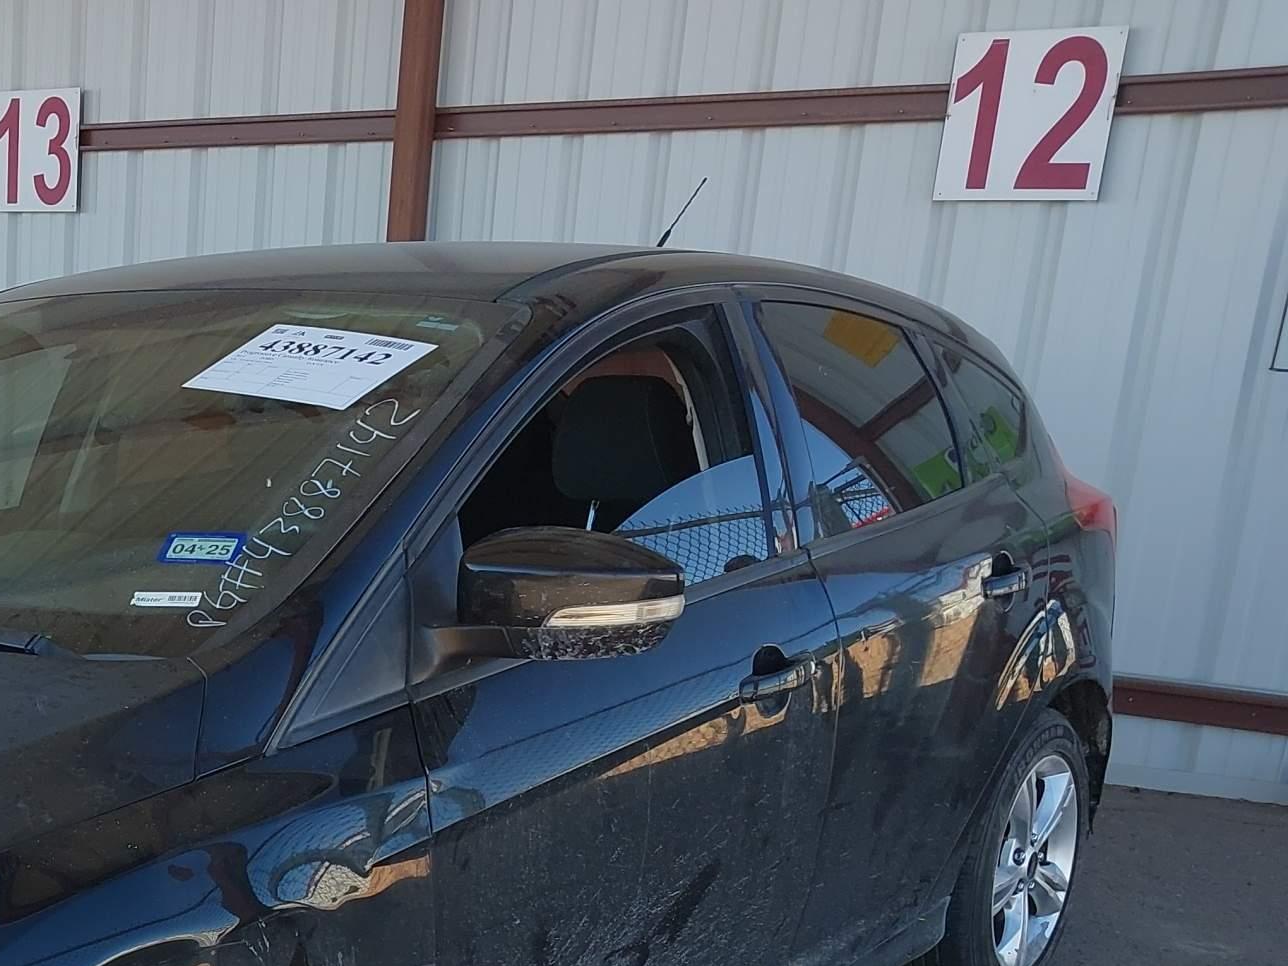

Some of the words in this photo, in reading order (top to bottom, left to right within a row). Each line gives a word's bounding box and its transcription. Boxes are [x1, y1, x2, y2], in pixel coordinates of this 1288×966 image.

[953, 35, 1109, 190] 12
[258, 339, 394, 366] 43887142
[172, 543, 197, 555] 04
[205, 544, 232, 556] 25
